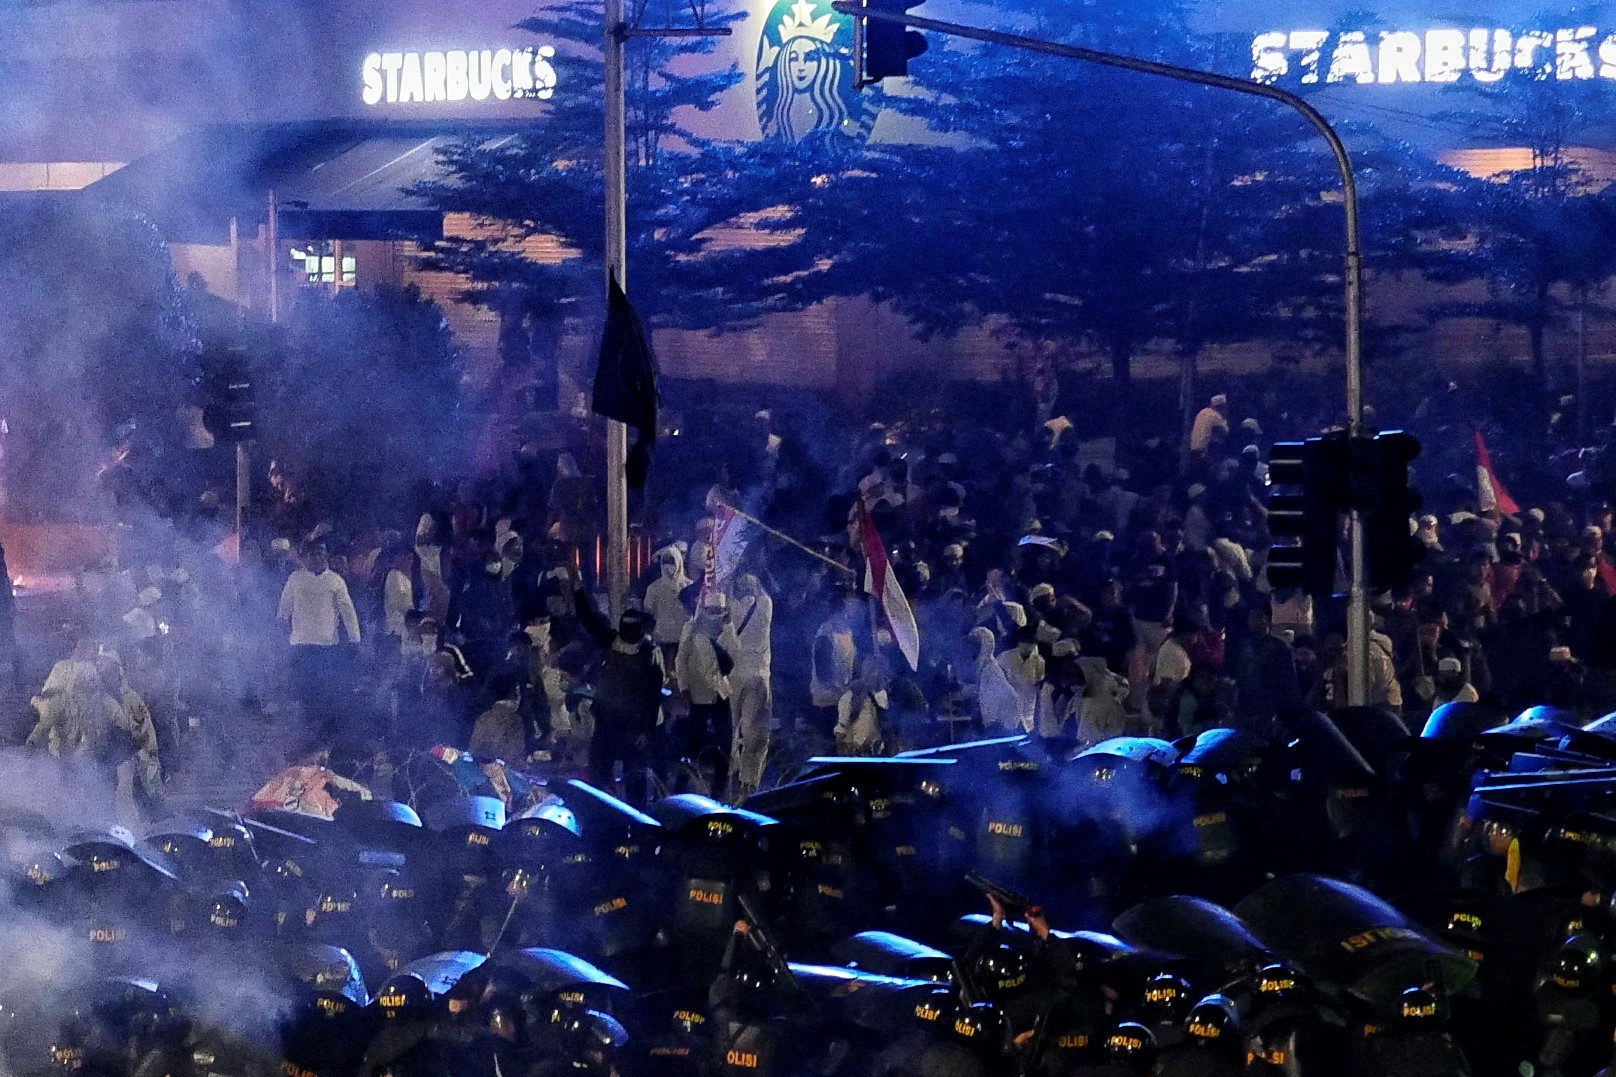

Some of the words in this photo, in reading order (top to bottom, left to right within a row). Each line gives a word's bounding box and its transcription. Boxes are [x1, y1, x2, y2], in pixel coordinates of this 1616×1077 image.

[362, 46, 556, 105] STARBUCKS
[988, 822, 1022, 836] POLISI
[690, 889, 723, 904] POLISI
